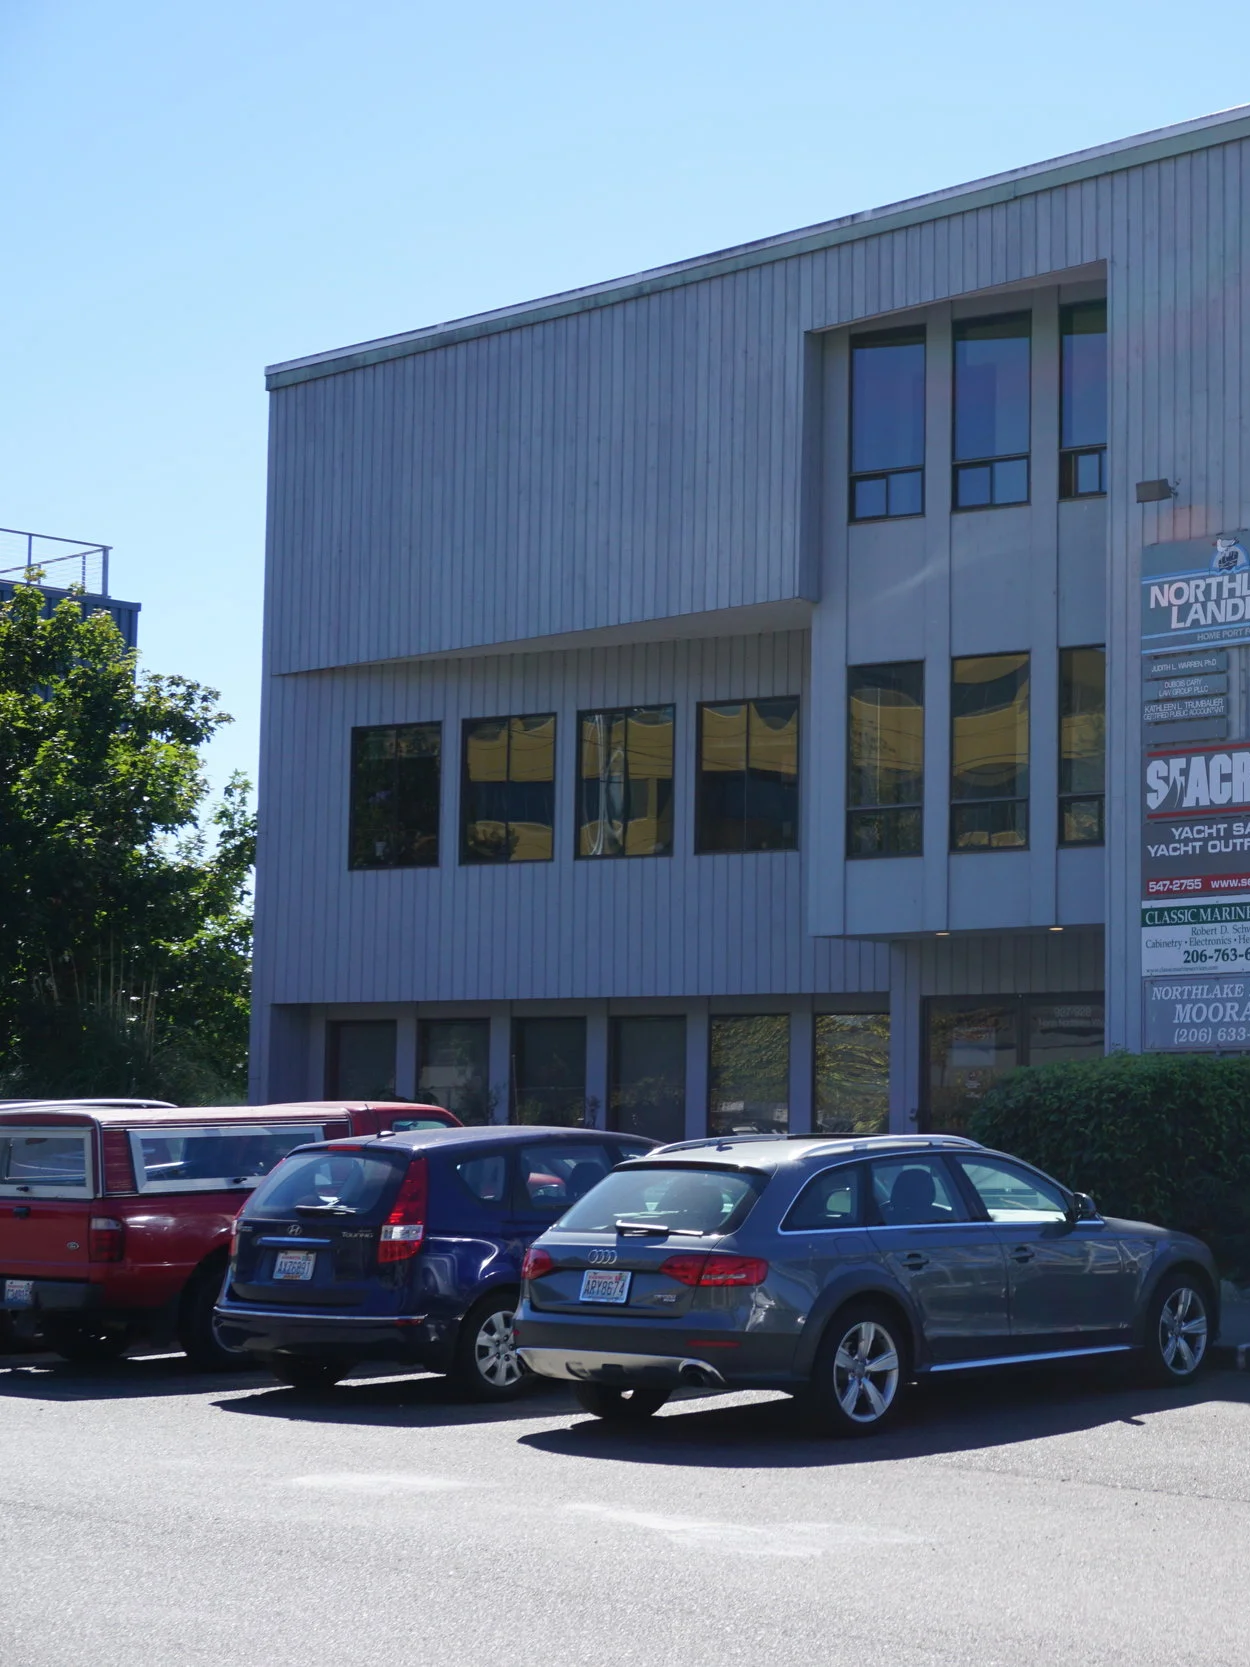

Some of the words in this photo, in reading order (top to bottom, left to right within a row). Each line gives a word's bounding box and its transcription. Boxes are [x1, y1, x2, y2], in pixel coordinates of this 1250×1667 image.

[1197, 631, 1221, 641] HOME
[1222, 629, 1242, 638] PORT
[1172, 687, 1193, 696] GROUP
[1144, 703, 1177, 713] KATHLEEN
[1171, 823, 1228, 840] YACHT
[1147, 841, 1203, 857] YACHT
[1148, 878, 1202, 892] 547-2755
[1145, 908, 1197, 925] CLASSIC
[1191, 926, 1217, 936] Robert
[1220, 925, 1229, 934] D.
[1145, 938, 1182, 950] Cabinetry
[1189, 936, 1232, 947] Electronics
[1152, 983, 1244, 1001] NORTHLAKE
[1174, 1026, 1212, 1045] (206)
